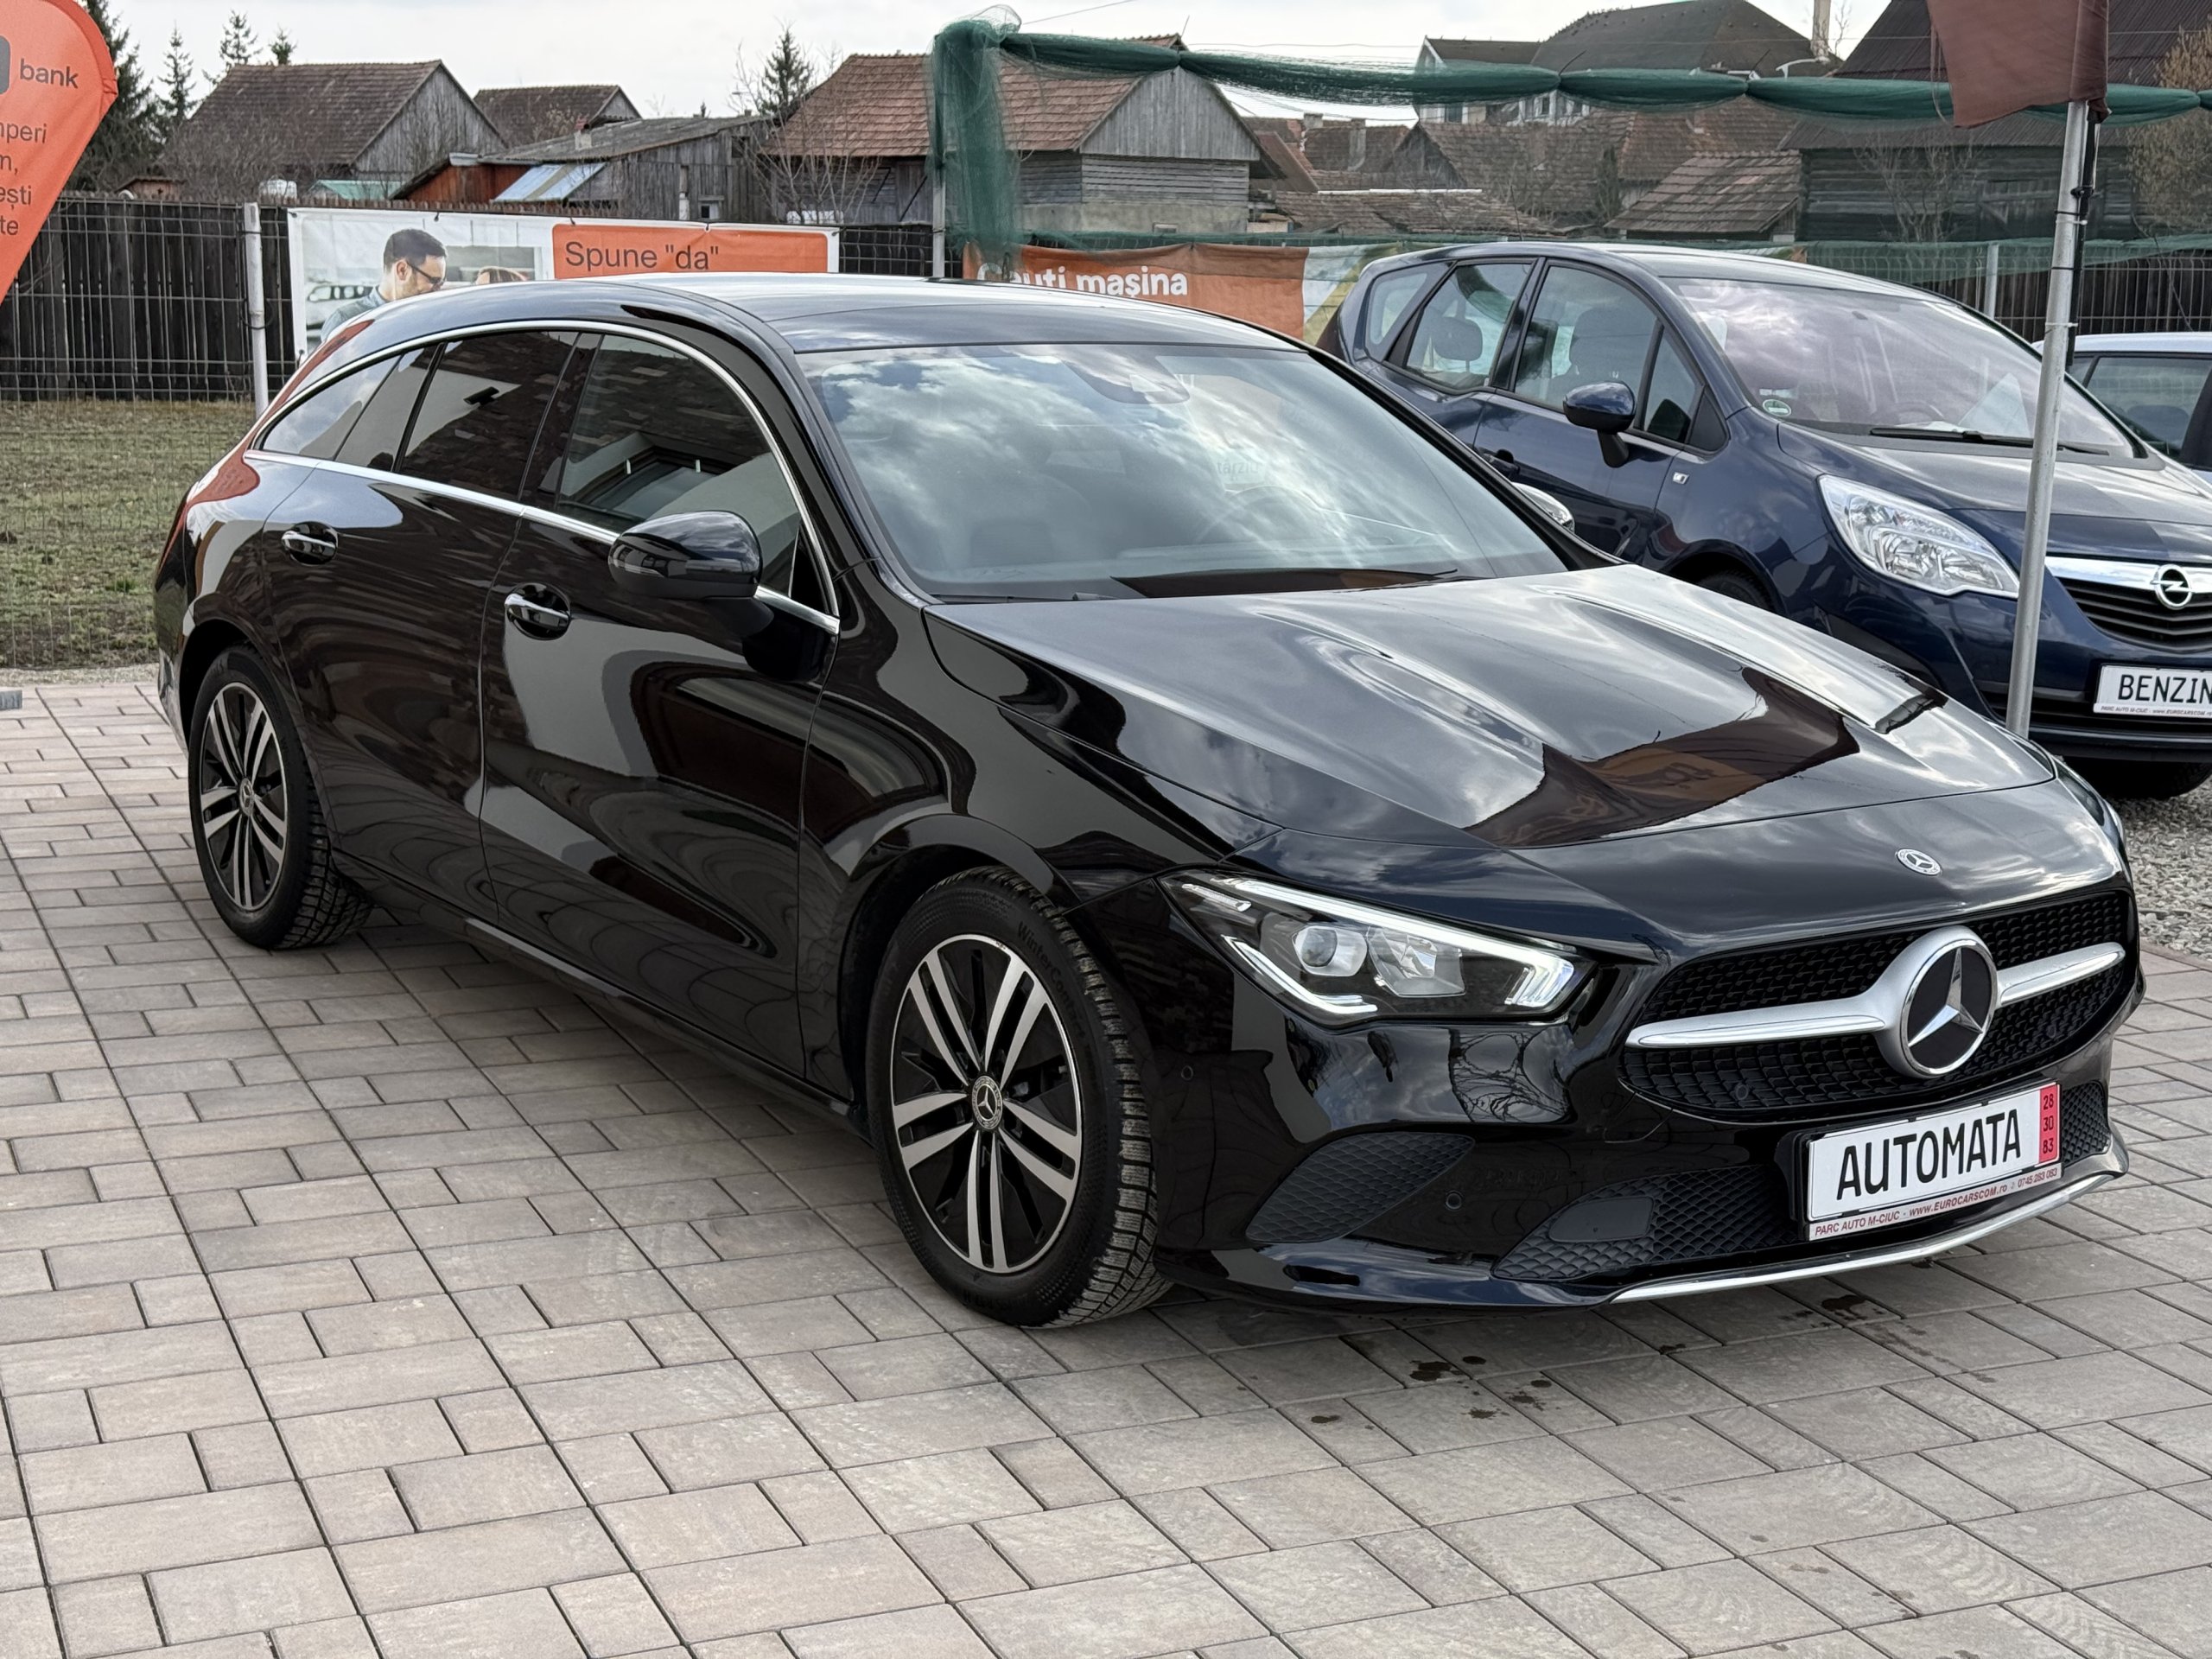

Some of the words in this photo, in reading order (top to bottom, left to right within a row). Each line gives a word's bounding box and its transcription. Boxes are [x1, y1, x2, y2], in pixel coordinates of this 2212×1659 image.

[20, 58, 79, 89] bank
[0, 123, 47, 143] peri
[565, 241, 658, 271] Spune
[664, 244, 719, 270] "da"
[2043, 1093, 2055, 1110] 28
[2043, 1116, 2055, 1132] 30
[1836, 1109, 2021, 1201] AUTOMATA
[2042, 1137, 2055, 1154] 83
[1815, 1223, 1840, 1236] PARC
[1840, 1217, 1866, 1231] AUTO
[1867, 1211, 1900, 1226] M-CIUC
